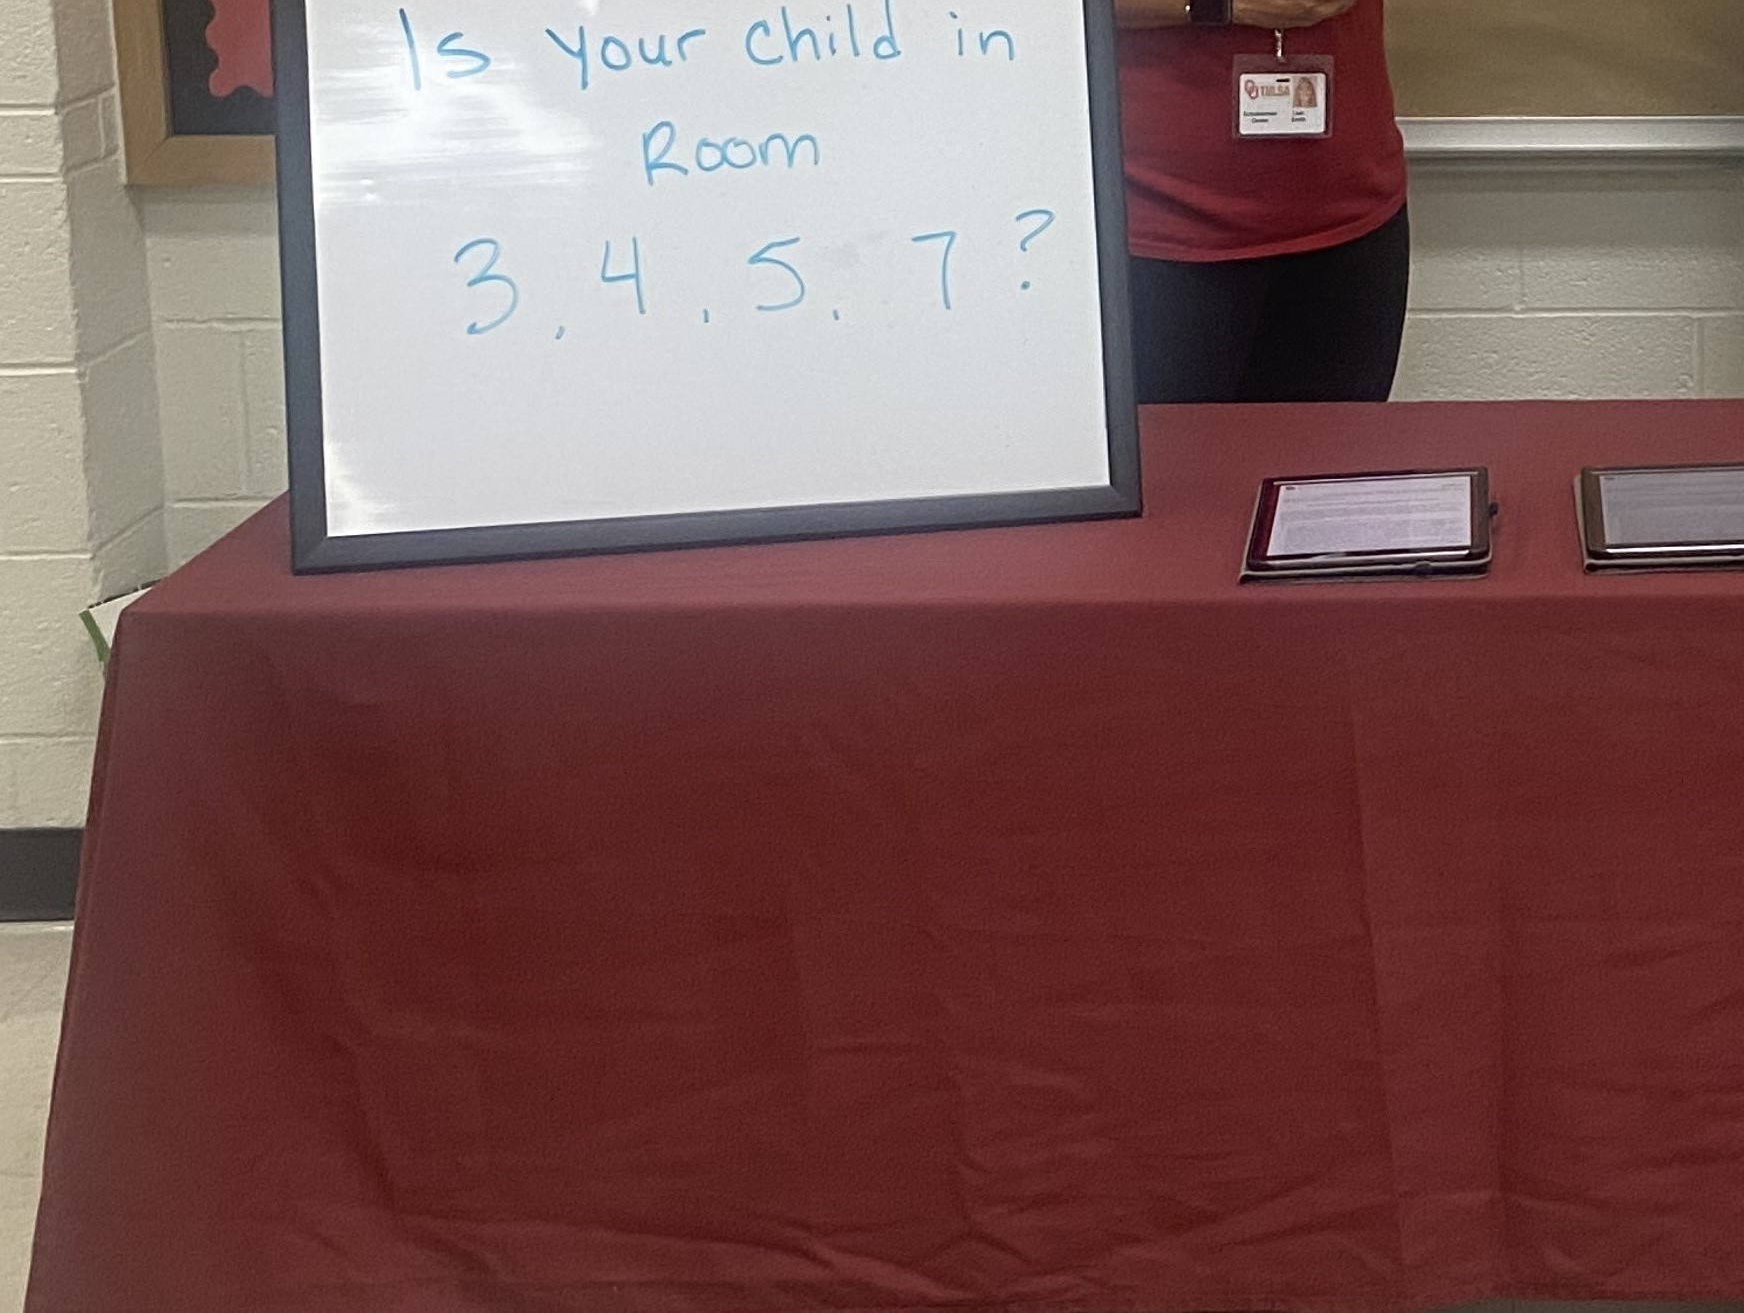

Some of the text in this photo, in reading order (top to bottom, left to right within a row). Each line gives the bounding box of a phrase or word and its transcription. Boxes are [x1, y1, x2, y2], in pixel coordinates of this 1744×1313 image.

[399, 7, 492, 90] Is
[948, 10, 1015, 62] in
[642, 120, 821, 187] Room
